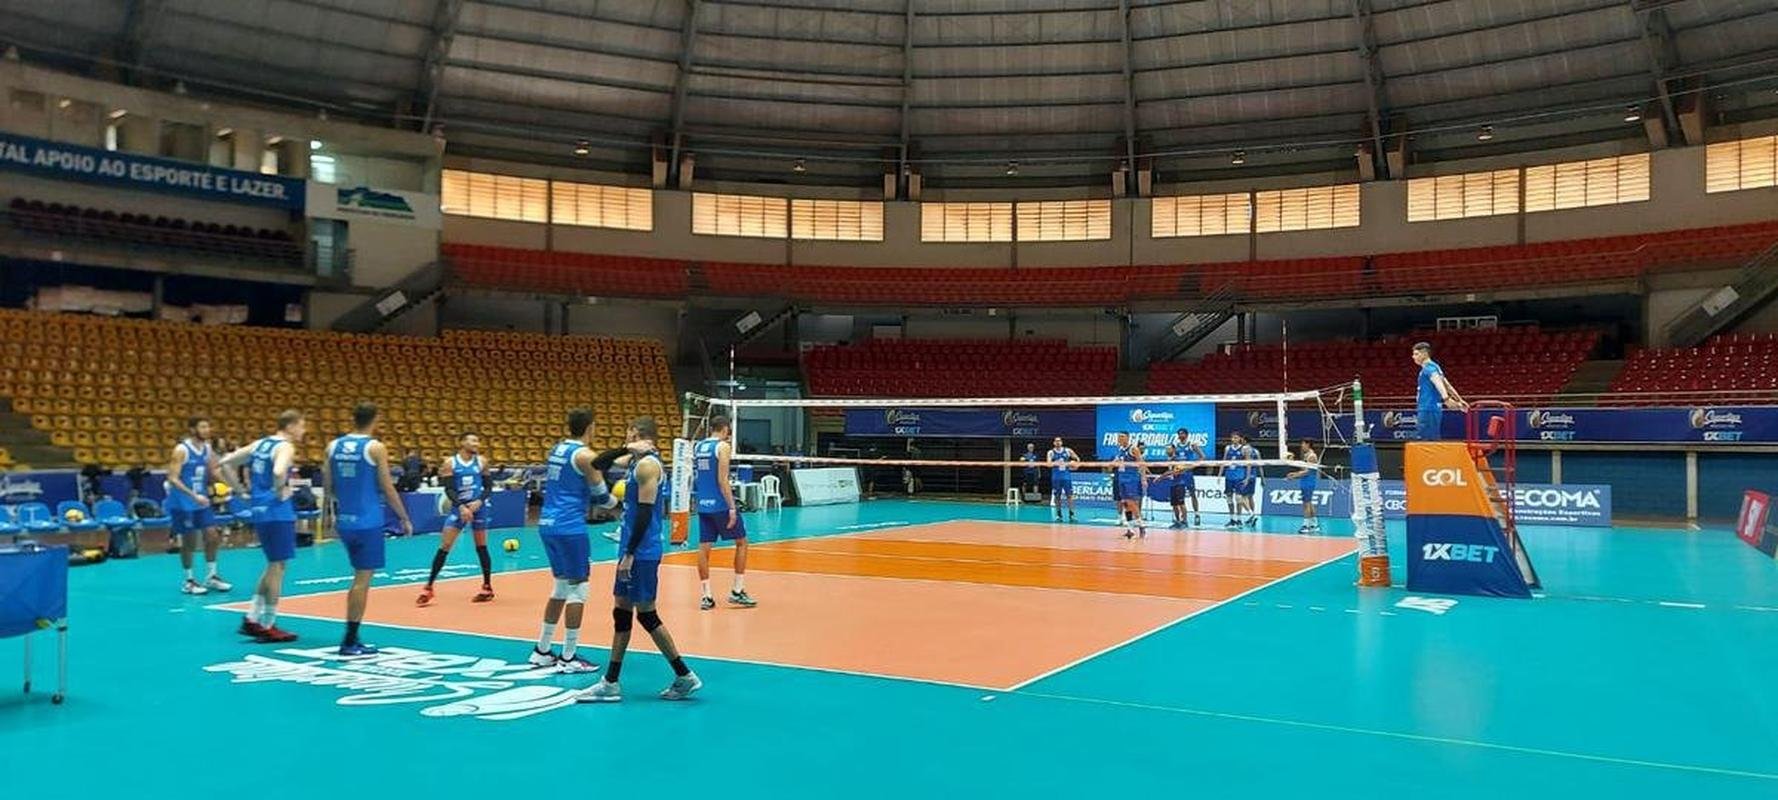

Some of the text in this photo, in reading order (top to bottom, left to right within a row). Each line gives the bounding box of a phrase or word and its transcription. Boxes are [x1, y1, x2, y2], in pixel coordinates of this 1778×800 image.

[34, 148, 96, 173] APOIO
[98, 158, 126, 178] AO
[130, 162, 214, 190] ESPORTE
[216, 175, 229, 192] E
[231, 177, 289, 200] LAZER.
[1422, 468, 1468, 487] GOL
[1422, 542, 1500, 564] 1XBET
